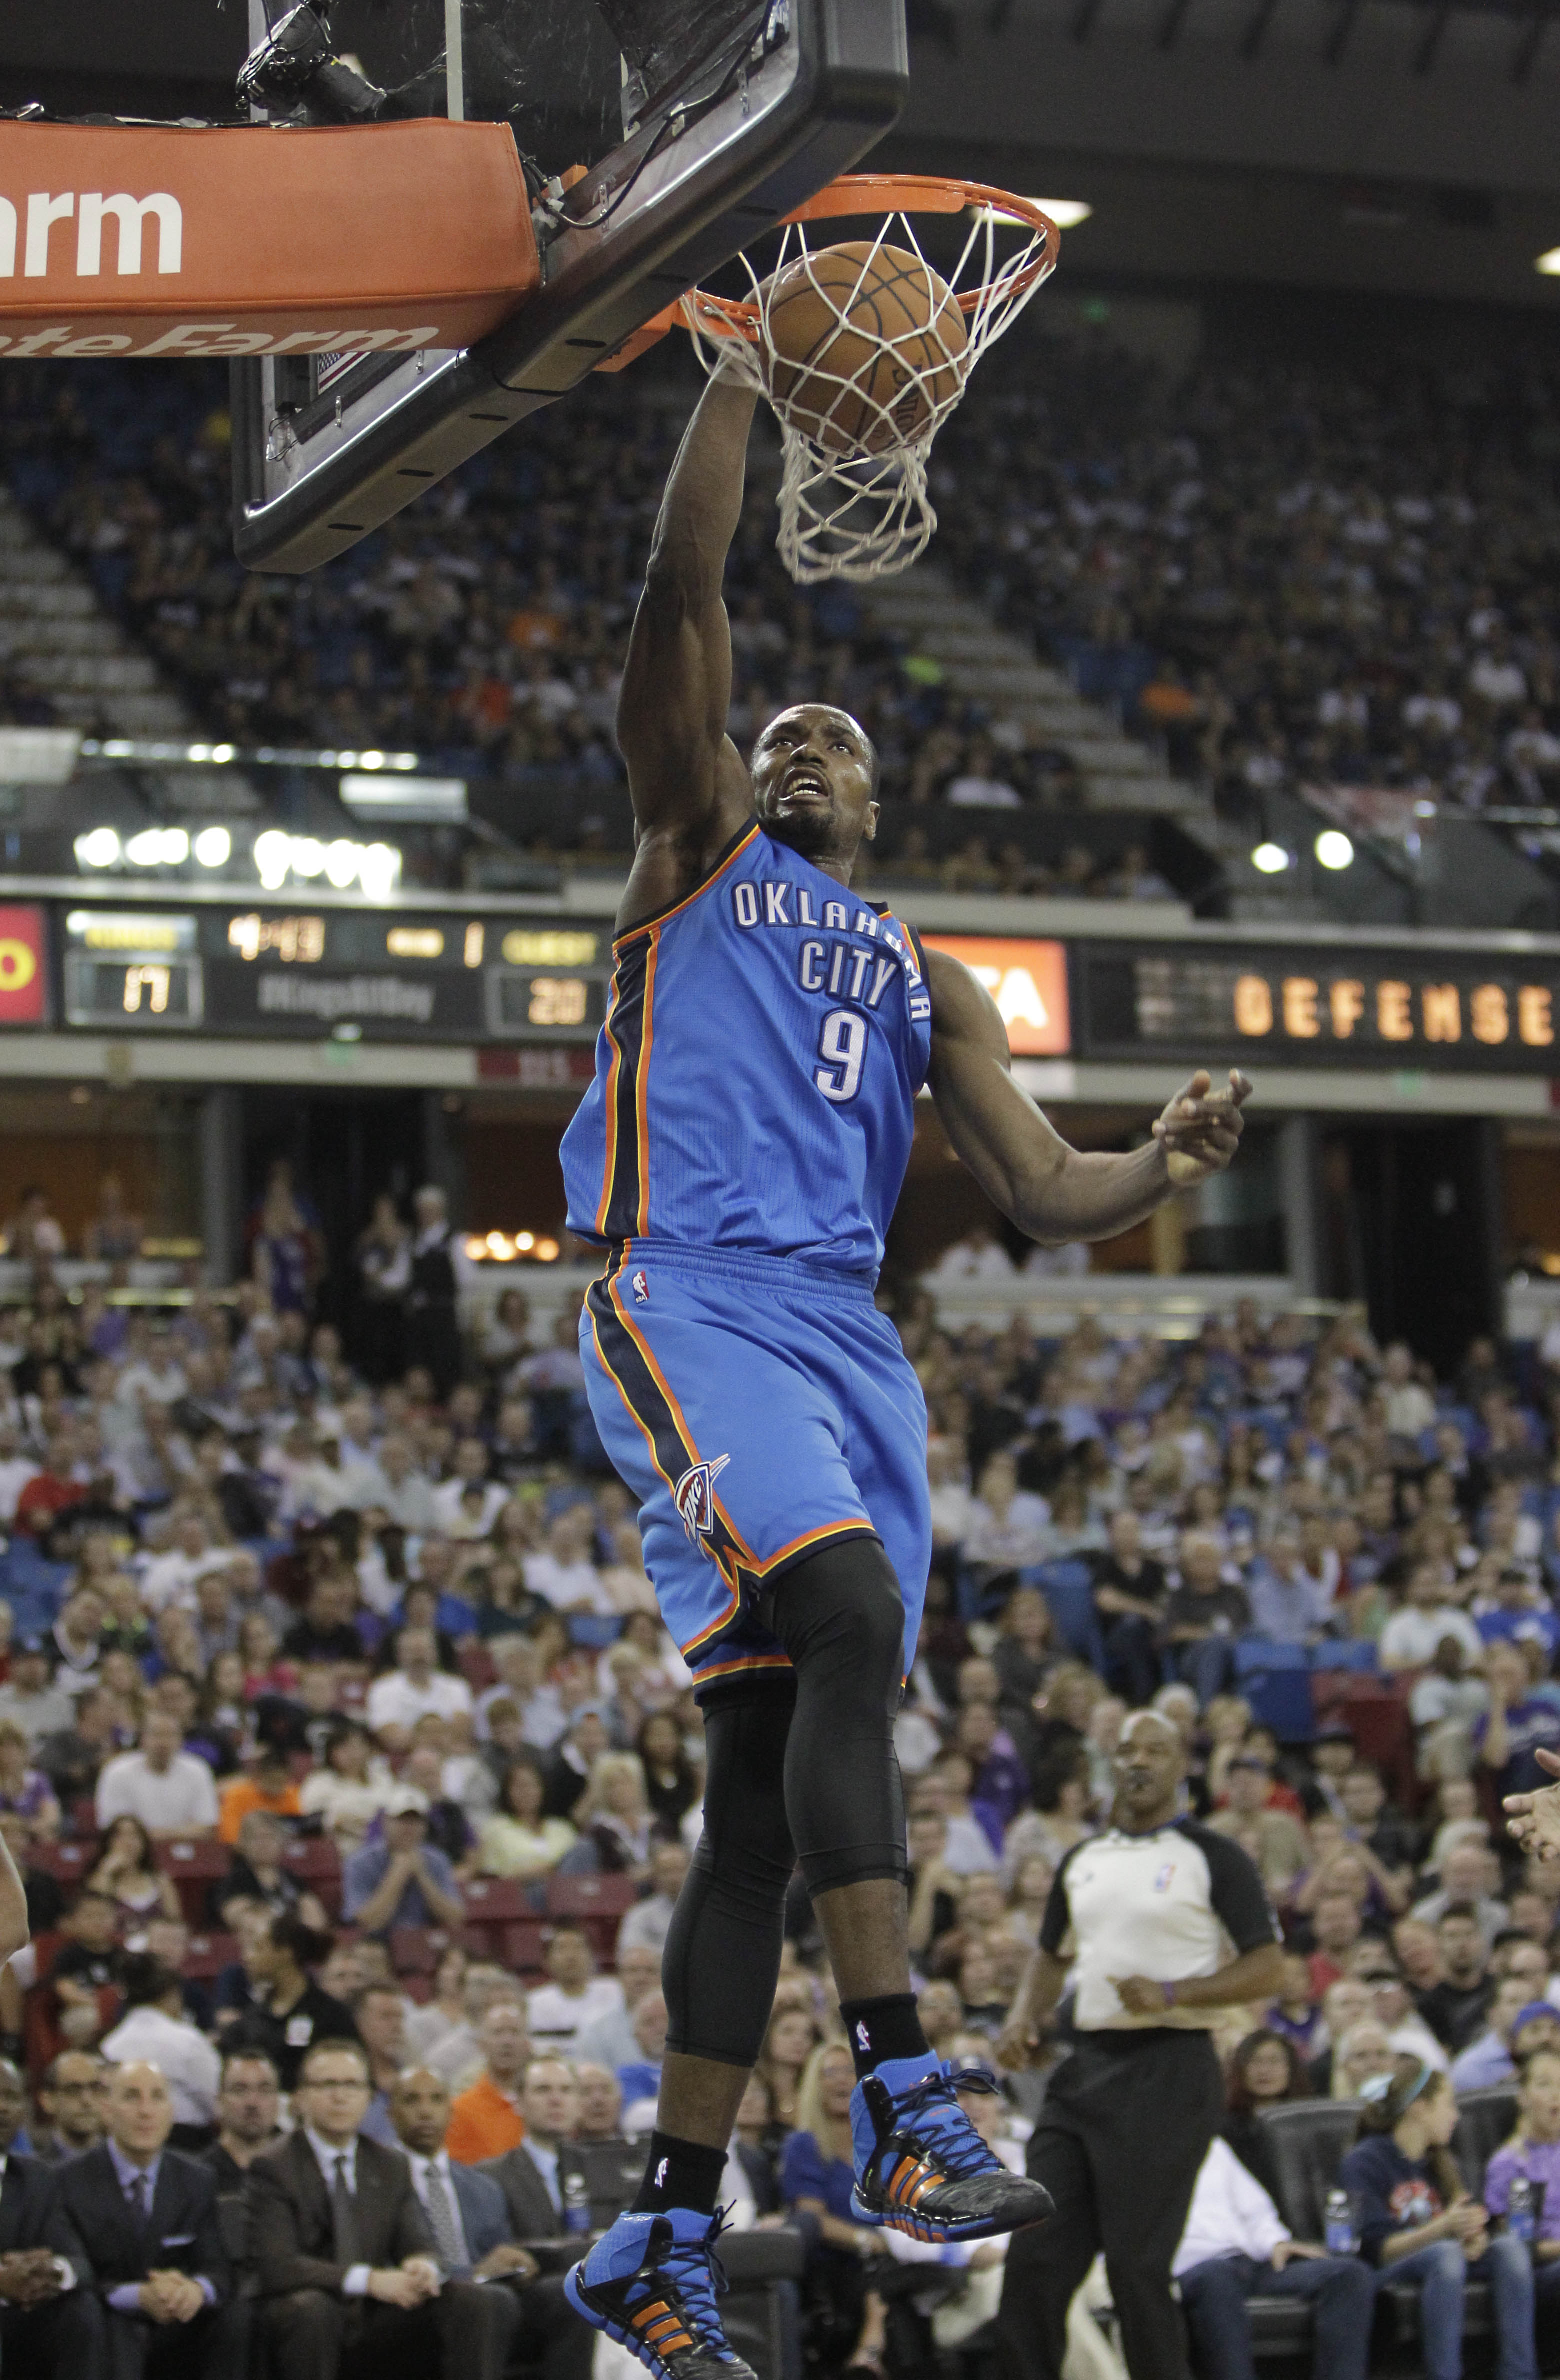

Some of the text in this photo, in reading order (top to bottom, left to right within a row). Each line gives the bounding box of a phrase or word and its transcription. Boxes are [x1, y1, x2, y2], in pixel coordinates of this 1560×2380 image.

[0, 324, 440, 356] te Farm
[800, 938, 900, 1010] CITY
[1234, 974, 1556, 1046] DEFENSE
[814, 1006, 871, 1105] 9
[636, 1295, 646, 1304] NBA
[684, 1476, 702, 1540] OKC
